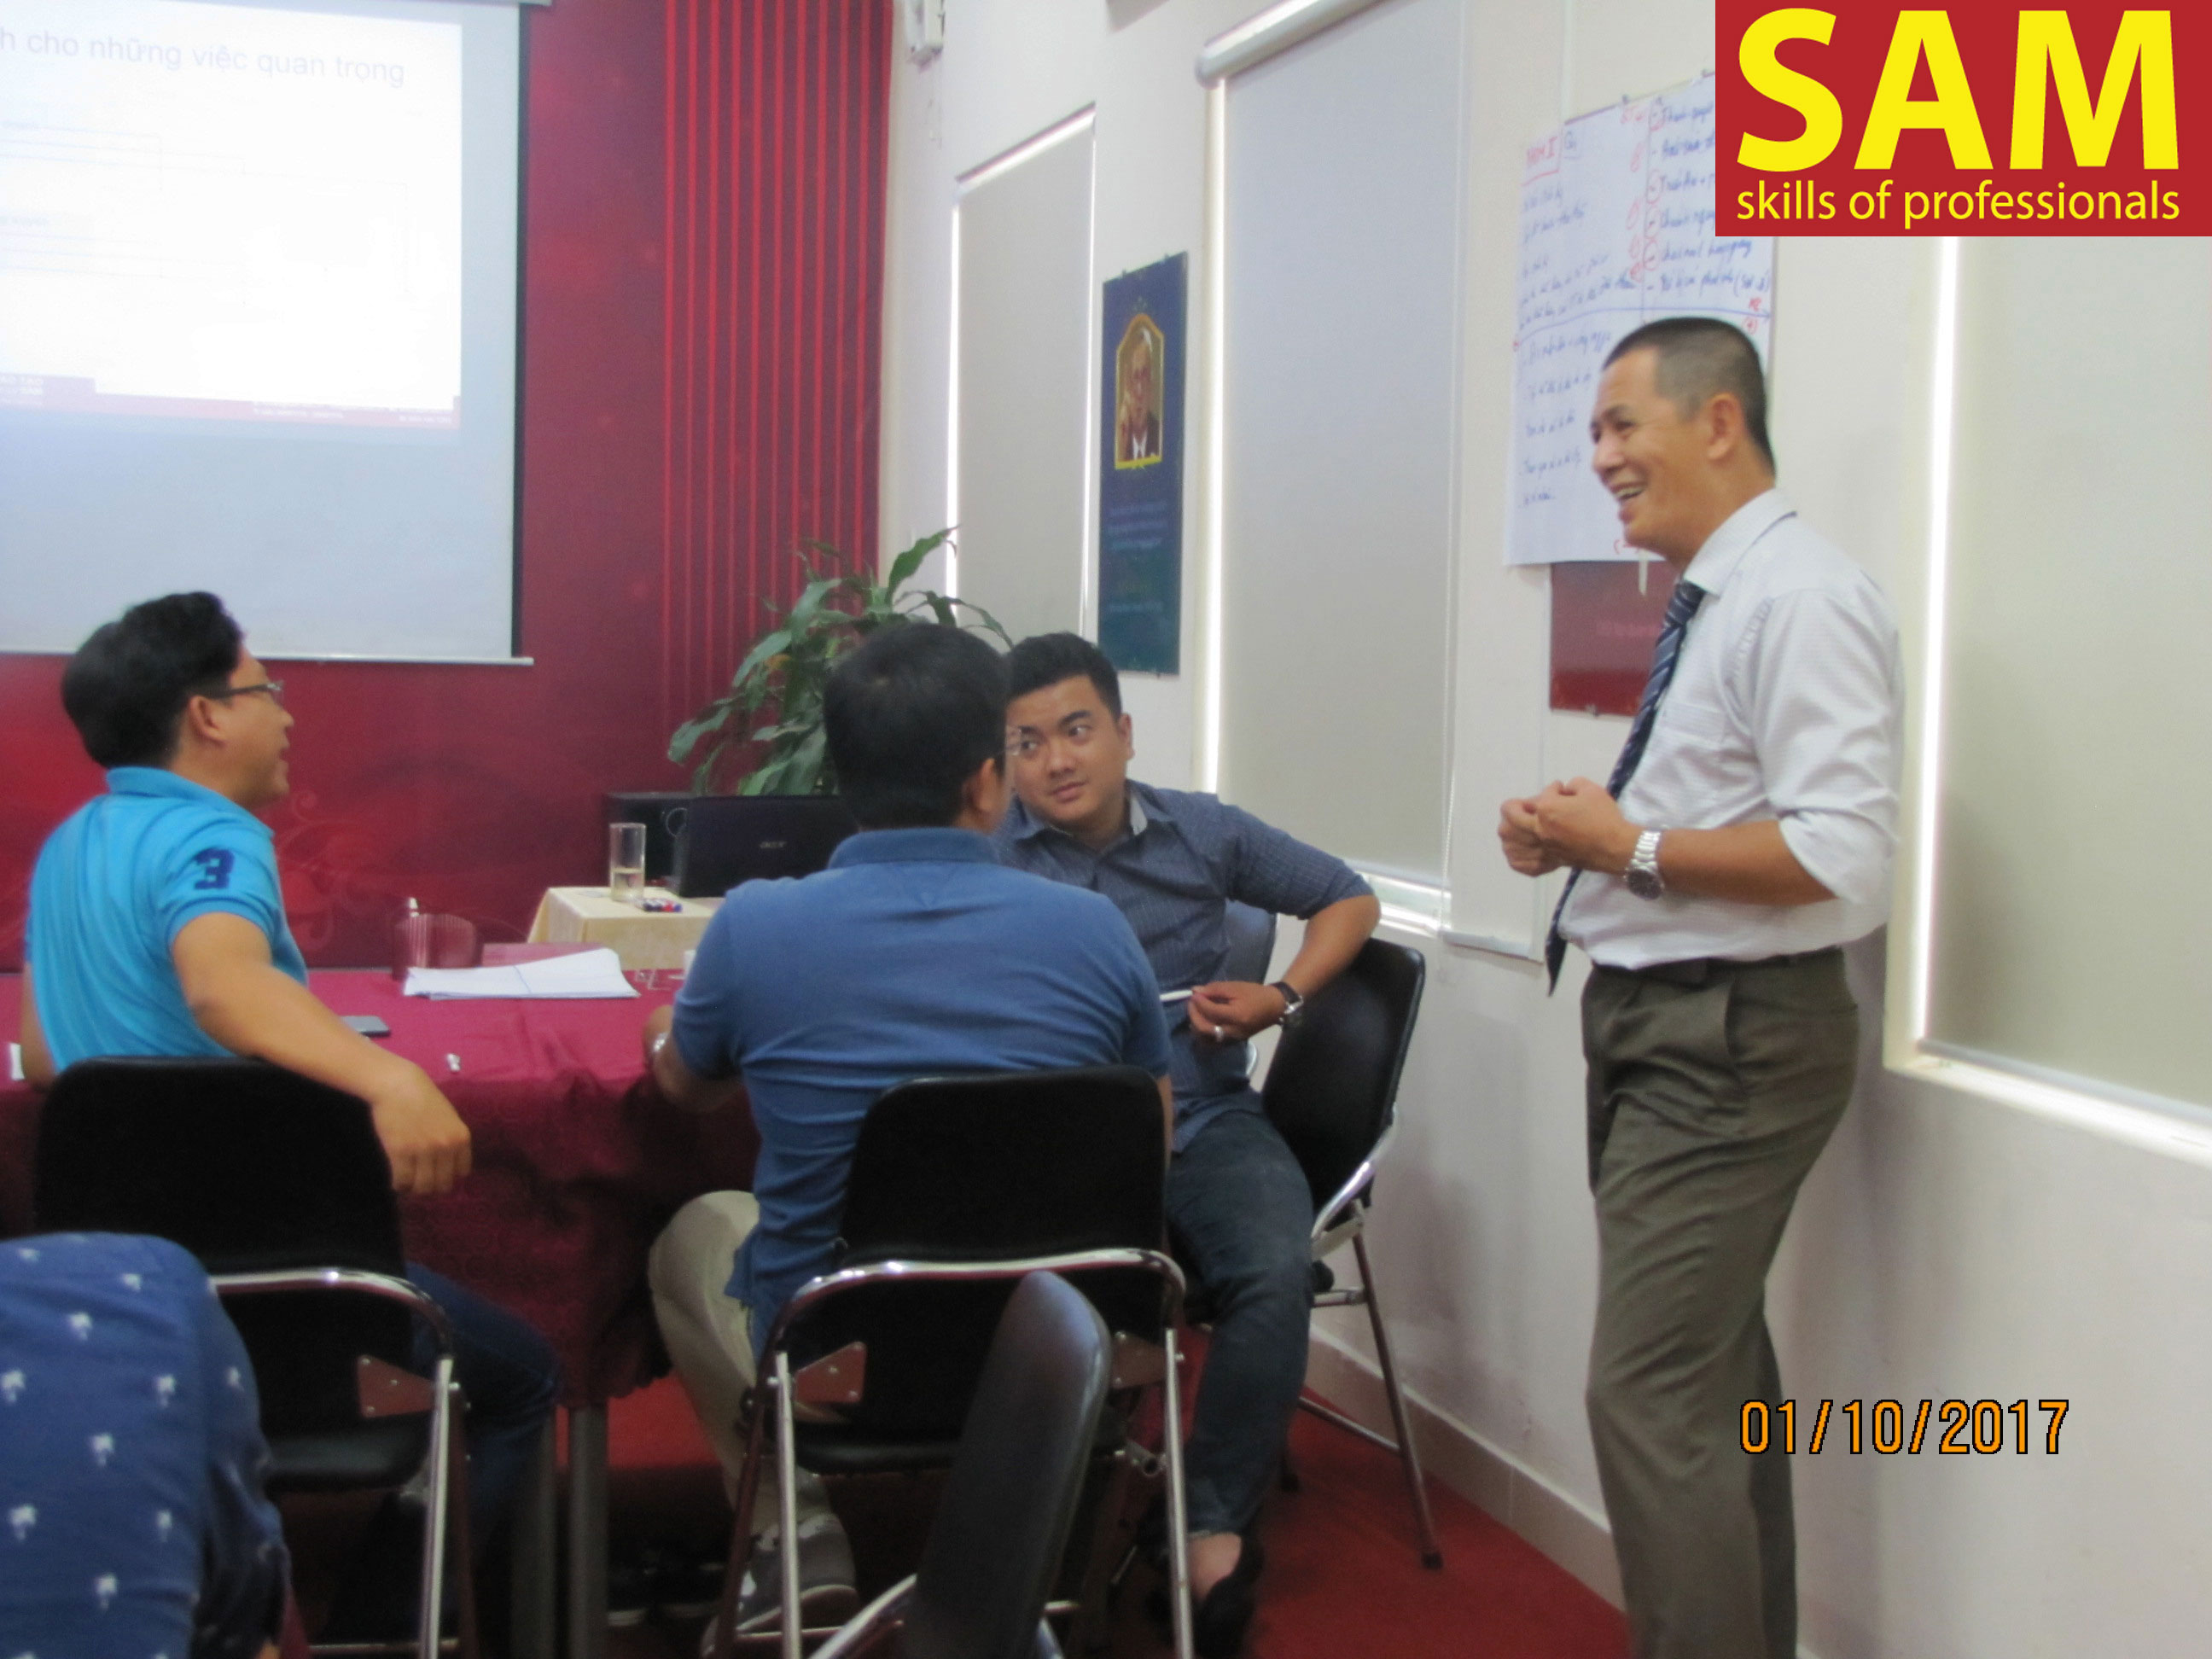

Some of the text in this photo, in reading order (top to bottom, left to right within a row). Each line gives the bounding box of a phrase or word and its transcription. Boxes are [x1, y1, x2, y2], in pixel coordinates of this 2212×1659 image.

[27, 29, 79, 57] cho
[89, 35, 183, 71] những
[193, 44, 247, 73] việc
[258, 54, 324, 79] quan
[335, 55, 405, 89] trọng
[192, 847, 236, 890] 3
